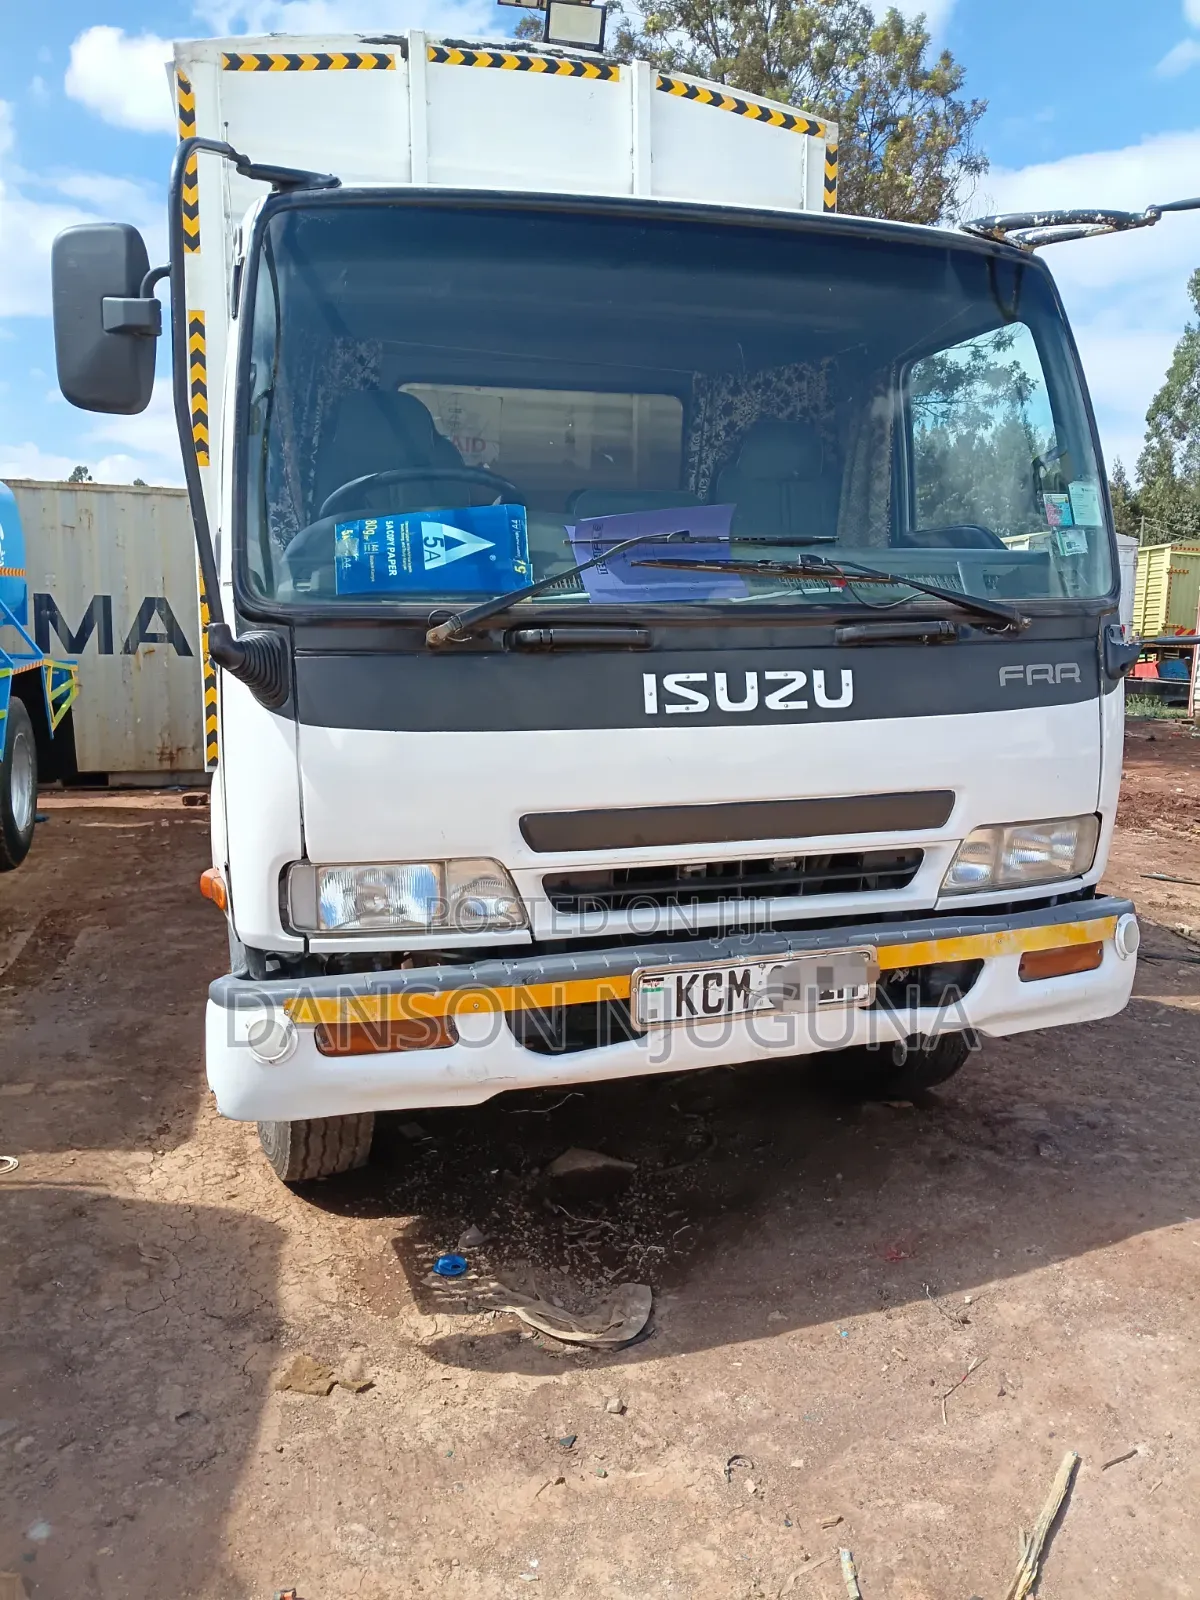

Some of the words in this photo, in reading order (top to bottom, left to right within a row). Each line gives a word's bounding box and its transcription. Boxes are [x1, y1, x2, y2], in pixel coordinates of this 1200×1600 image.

[386, 530, 395, 546] COPY
[423, 536, 445, 562] 5A
[387, 547, 398, 576] PAPER
[643, 669, 853, 714] ISUZU
[675, 968, 752, 1018] KCM
